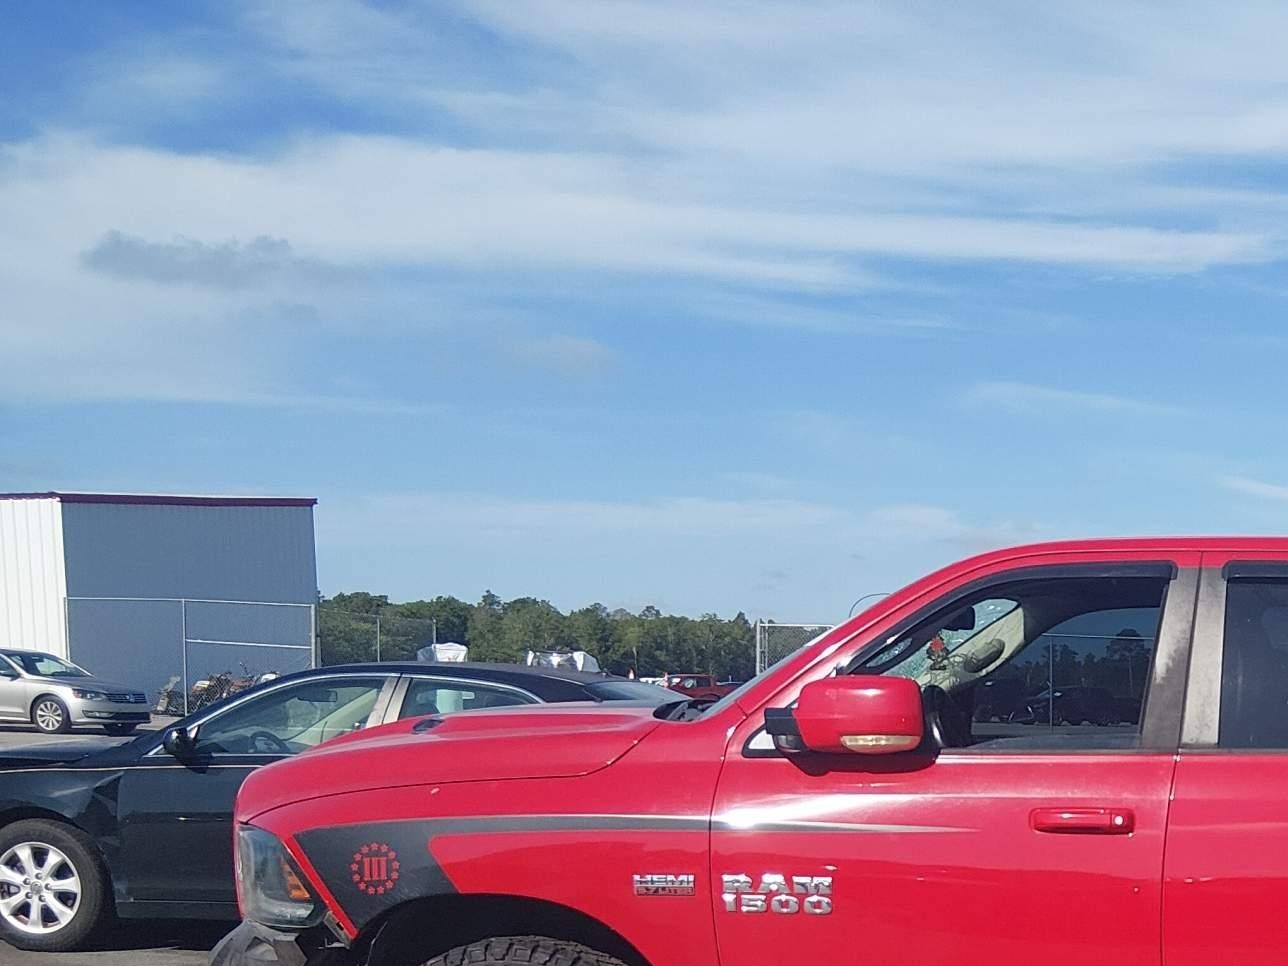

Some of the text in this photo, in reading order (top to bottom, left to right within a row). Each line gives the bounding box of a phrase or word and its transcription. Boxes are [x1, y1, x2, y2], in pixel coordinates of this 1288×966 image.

[632, 874, 695, 887] HEMI
[721, 873, 833, 894] RAM
[721, 893, 833, 914] 1500
